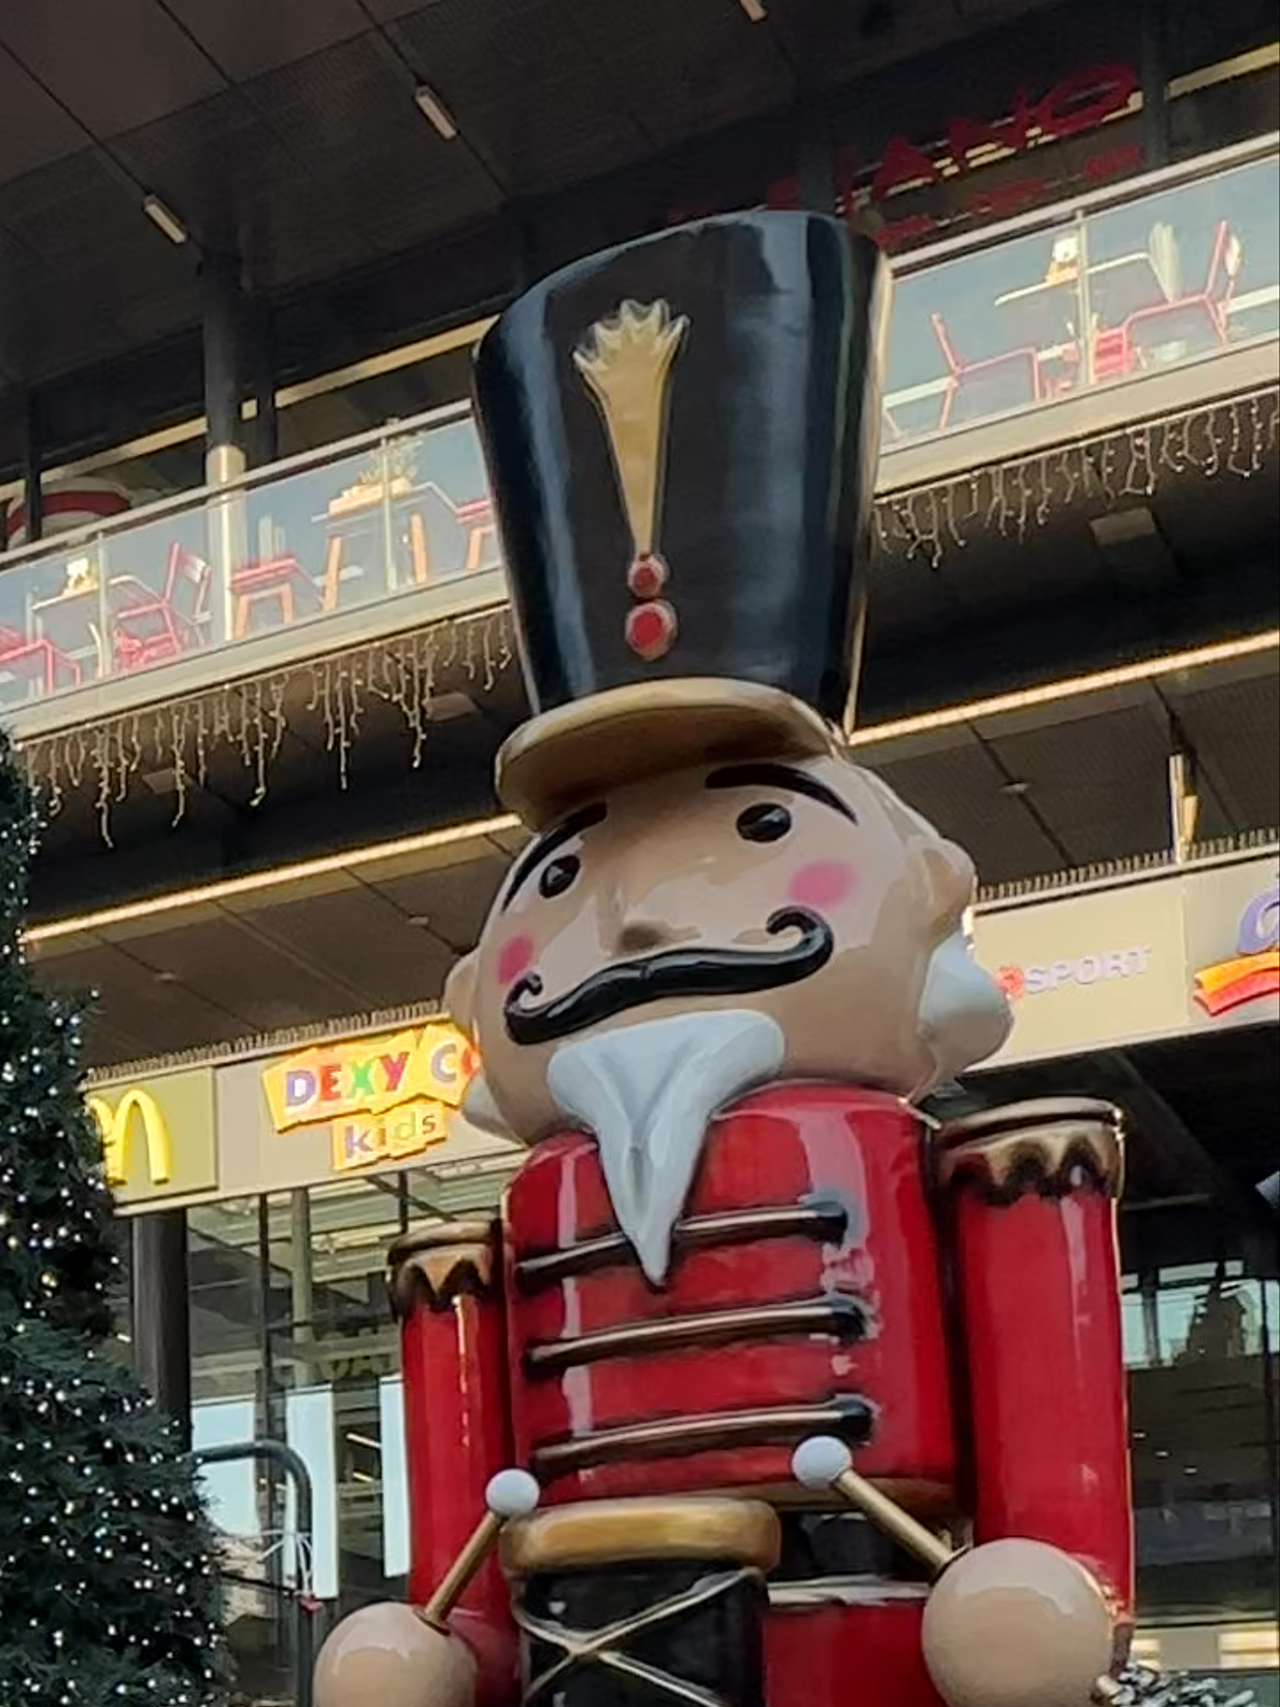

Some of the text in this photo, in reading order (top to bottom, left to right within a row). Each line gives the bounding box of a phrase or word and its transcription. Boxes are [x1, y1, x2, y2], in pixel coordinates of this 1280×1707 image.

[1025, 945, 1153, 993] SPORT
[285, 1050, 410, 1110] DEXY
[346, 1112, 437, 1159] kids
